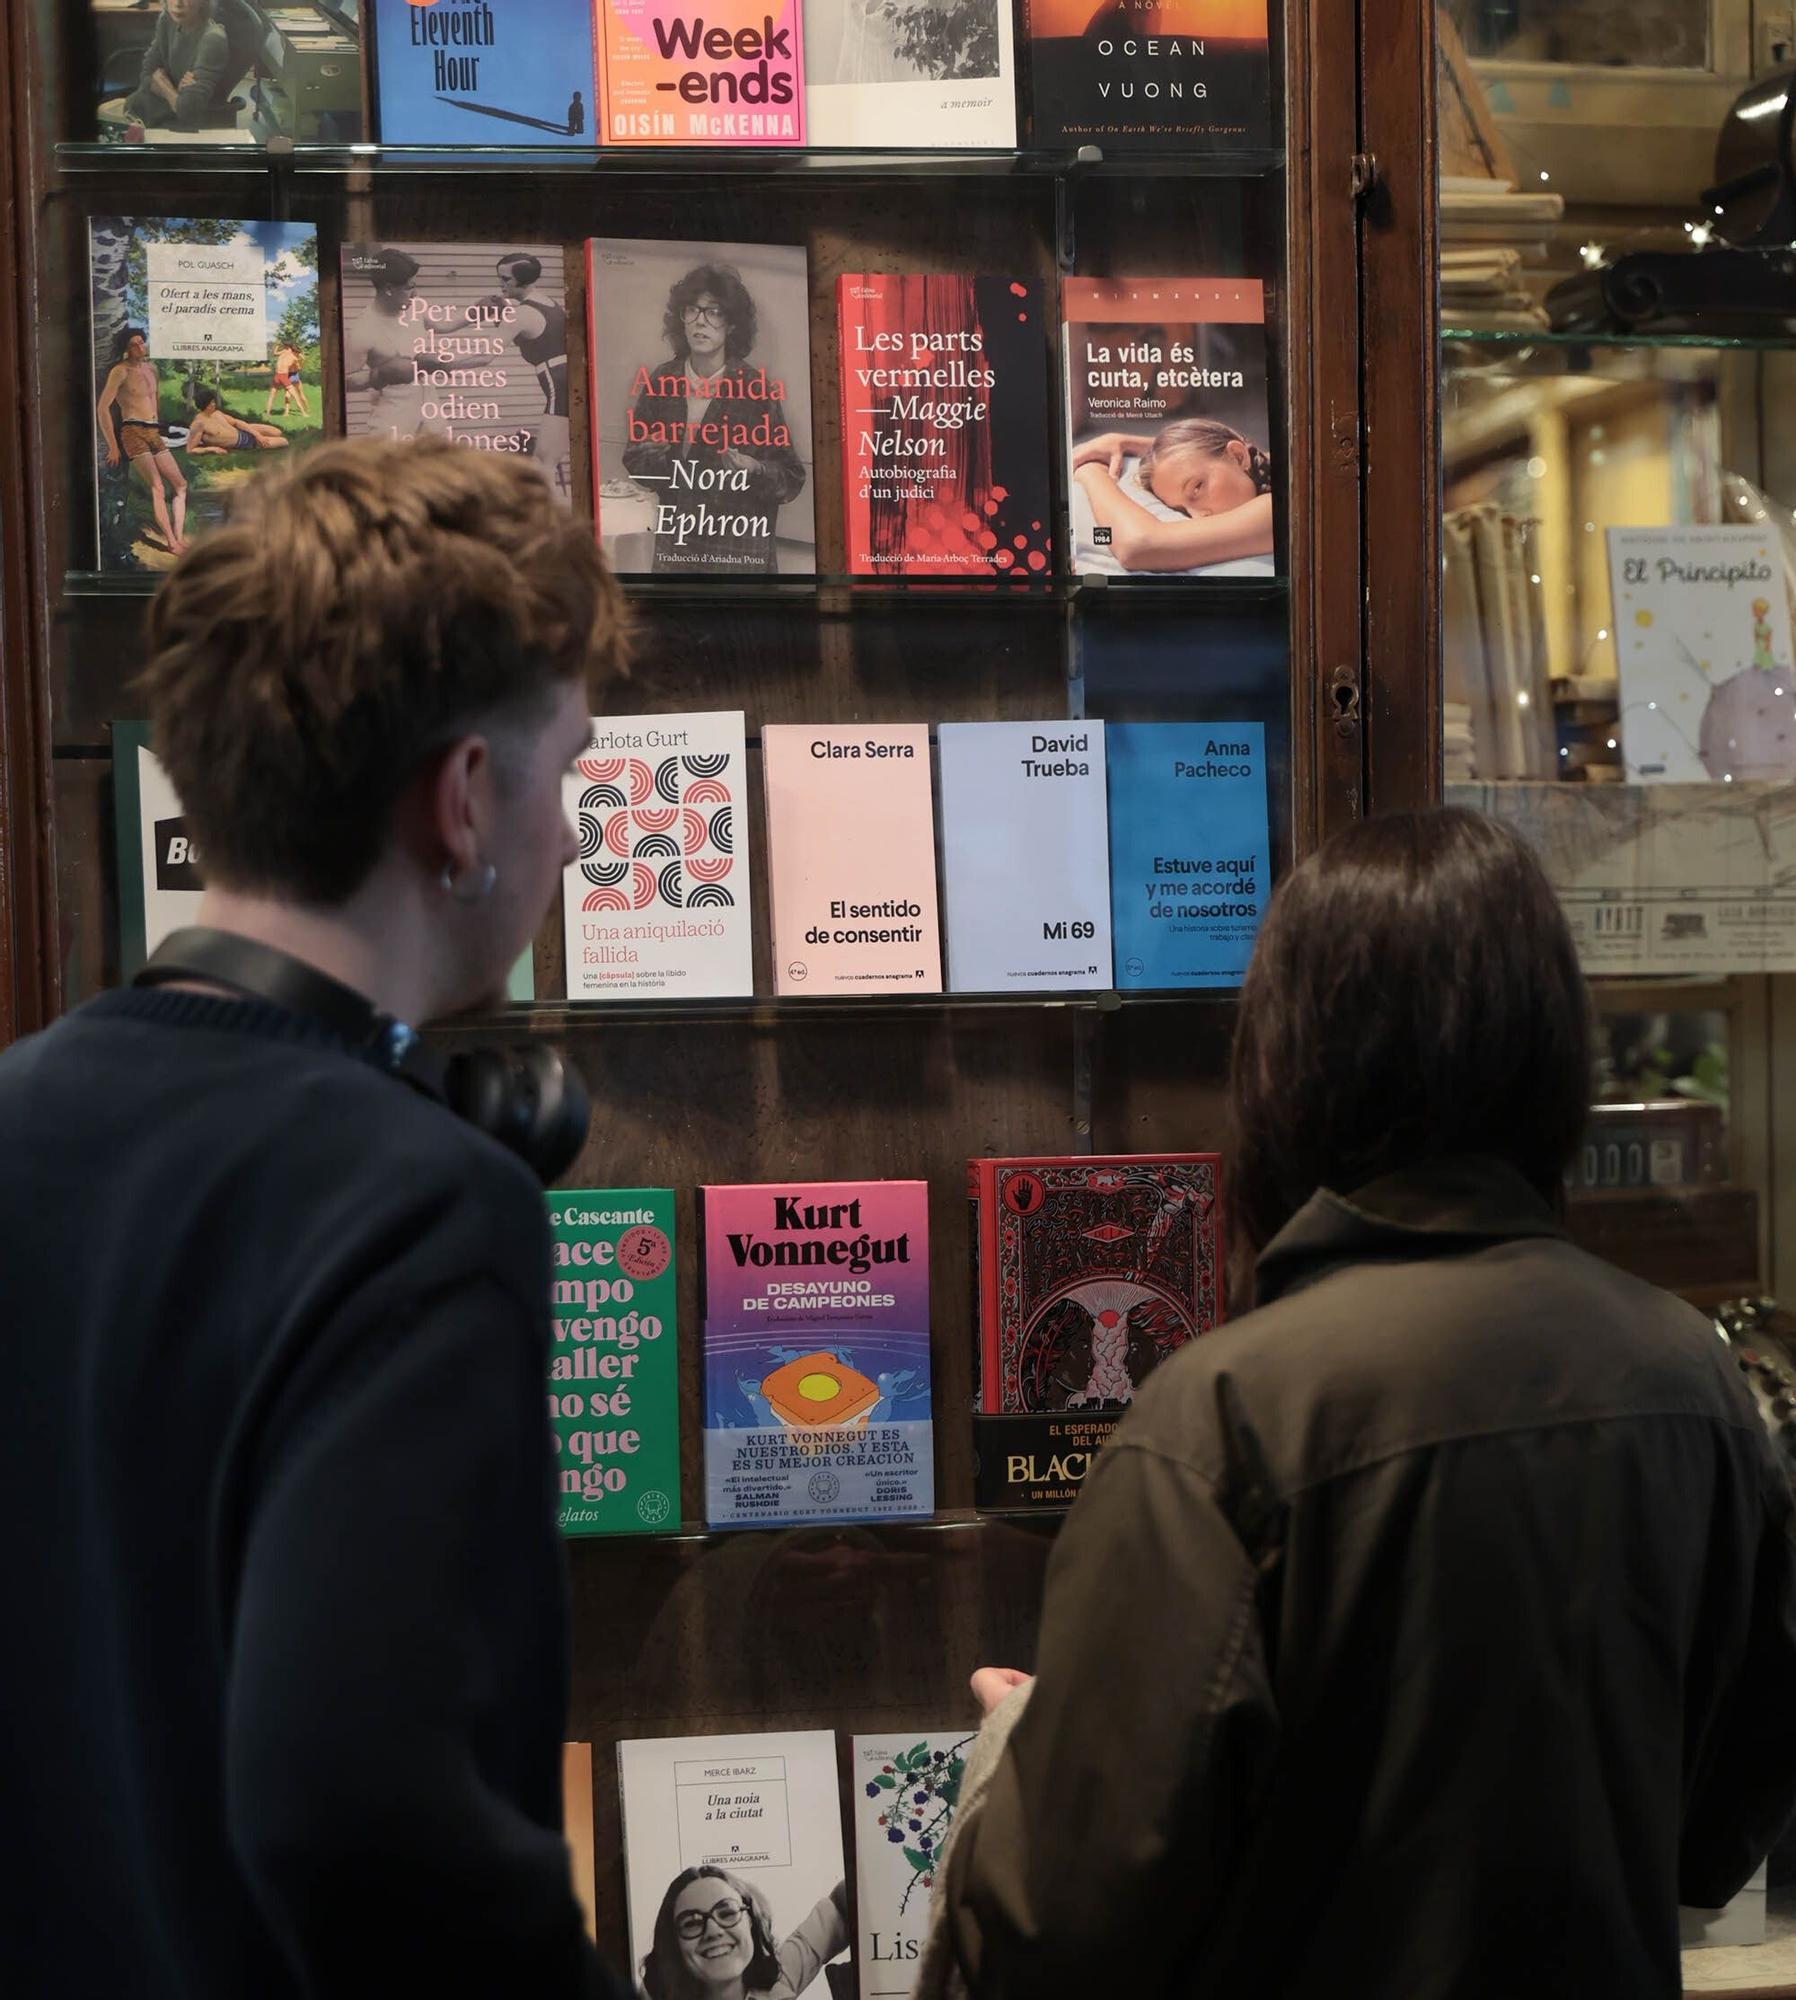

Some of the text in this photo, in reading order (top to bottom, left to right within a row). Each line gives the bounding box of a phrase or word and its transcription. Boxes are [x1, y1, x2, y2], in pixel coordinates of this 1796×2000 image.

[410, 3, 494, 46] Eleventh
[652, 15, 792, 60] Week
[1098, 40, 1205, 56] OCEAN
[434, 50, 480, 91] Hour
[656, 60, 793, 104] -ends
[1098, 83, 1208, 98] VUONG
[951, 97, 993, 108] memoir
[614, 111, 794, 136] OISÍN McKENNA
[178, 260, 234, 269] POL GUASCH
[160, 288, 255, 302] Ofert a les mans,
[1093, 292, 1240, 300] MIRMANDA
[161, 303, 255, 315] el paradís crema
[398, 298, 518, 330] ¿Per què
[413, 329, 504, 363] alguns
[854, 326, 983, 360] Les parts
[1087, 342, 1194, 363] La vida és
[411, 361, 508, 388] homes
[630, 366, 787, 401] Amanida
[855, 361, 996, 388] vermelles
[1087, 366, 1244, 391] curta, etcètera
[421, 393, 501, 419] odien
[1087, 397, 1167, 408] Veronica Raimo
[626, 408, 791, 454] barrejada
[857, 430, 946, 457] Nelson
[858, 465, 957, 483] Autobiografia
[859, 484, 935, 502] d'un judici
[654, 503, 771, 546] Ephron
[656, 552, 700, 563] Traducció
[743, 555, 766, 565] Pous
[859, 553, 1008, 564] Traducció de Terrades
[1622, 556, 1773, 588] El Principito
[589, 730, 689, 750] arlota Gurt
[1031, 734, 1088, 752] David
[1204, 740, 1250, 756] Anna
[810, 741, 914, 759] Clara Serra
[1021, 760, 1089, 778] Trueba
[1174, 761, 1251, 778] Pacheco
[1153, 855, 1256, 877] Estuve aquí
[1145, 877, 1256, 900] y me acordé
[830, 900, 921, 918] El sentido
[1150, 901, 1257, 918] de nosotros
[582, 919, 725, 943] Una aniquilació
[805, 924, 923, 944] de consentir
[1043, 921, 1095, 940] Mi 69
[583, 946, 639, 964] fallida
[636, 970, 656, 978] sobre
[564, 1207, 655, 1226] Cascante
[774, 1196, 863, 1230] Kurt
[552, 1241, 614, 1266] ace
[726, 1232, 911, 1275] Vonnegut
[552, 1278, 634, 1313] mpo
[767, 1280, 872, 1296] DESAYUNO
[743, 1294, 896, 1311] DE CAMPEONES
[550, 1346, 640, 1380] aller
[590, 1383, 632, 1418] sé
[746, 1429, 900, 1446] KURT VONNEGUT ES
[1050, 1425, 1062, 1435] EL
[568, 1428, 641, 1465] que
[736, 1441, 910, 1459] NUESTRO DIOS. Y ESTA
[1073, 1436, 1092, 1446] DEL
[732, 1456, 832, 1471] ES SU MEJOR
[870, 1494, 913, 1502] LESSING
[1031, 1488, 1077, 1499] UN MILLÓN
[735, 1500, 780, 1508] RUSHDIE
[732, 1767, 757, 1775] IBARZ
[707, 1792, 761, 1806] Una noia
[705, 1807, 764, 1820] a la ciutat
